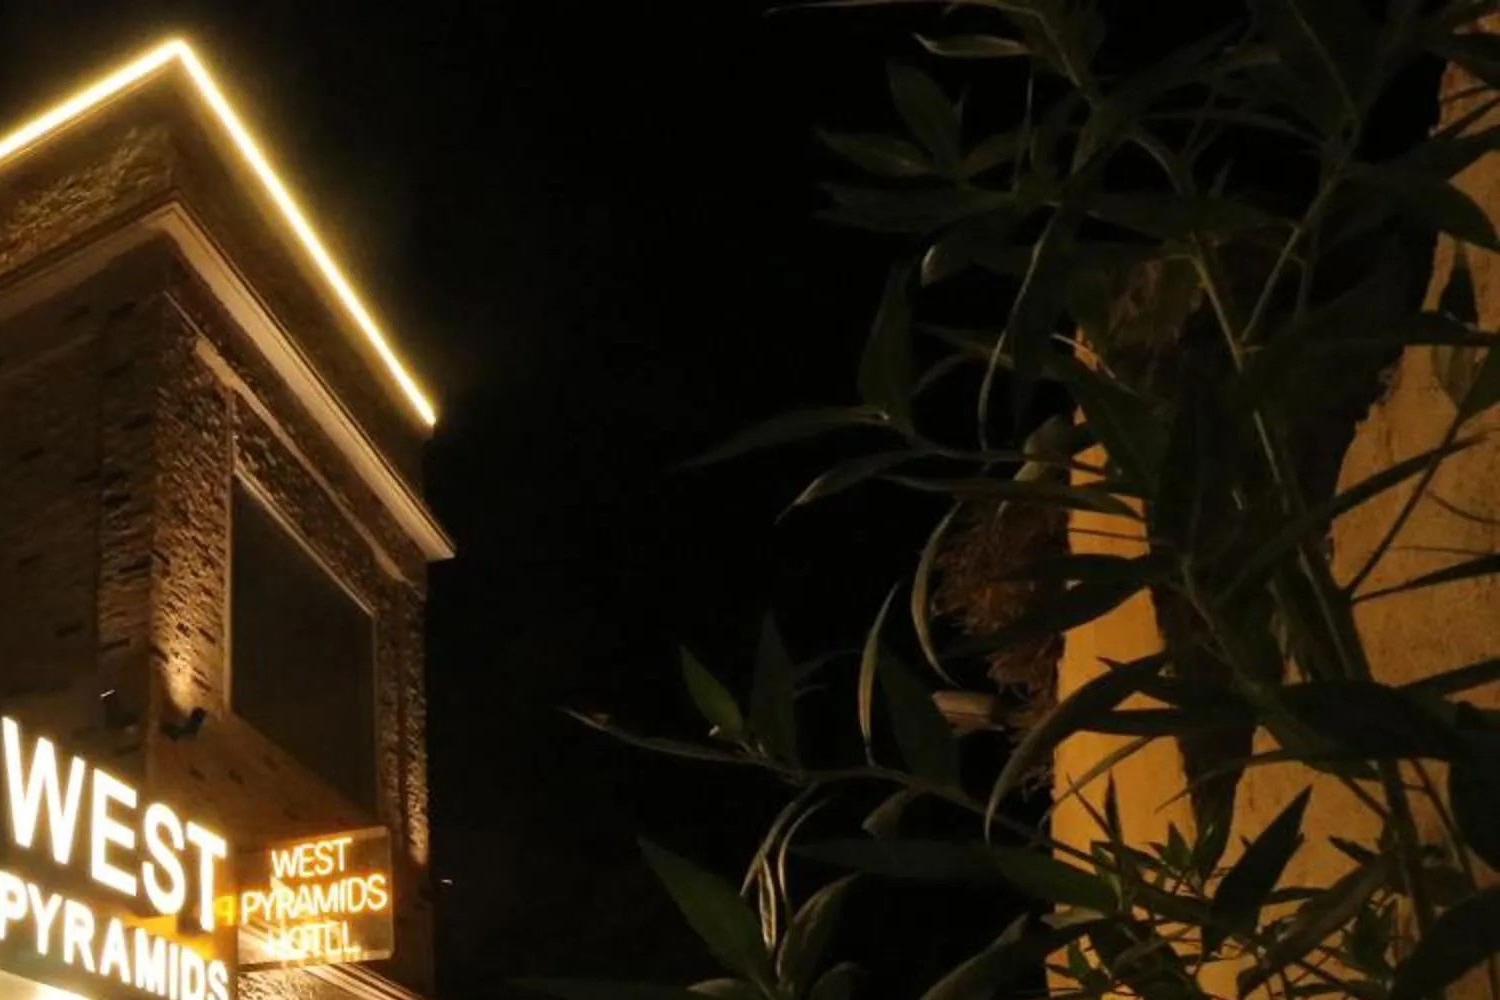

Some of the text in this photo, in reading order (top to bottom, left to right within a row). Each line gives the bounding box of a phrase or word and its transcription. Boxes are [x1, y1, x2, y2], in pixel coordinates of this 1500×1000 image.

[1, 715, 228, 933] WEST
[271, 837, 353, 879] WEST
[241, 873, 389, 924] PYRAMIDS
